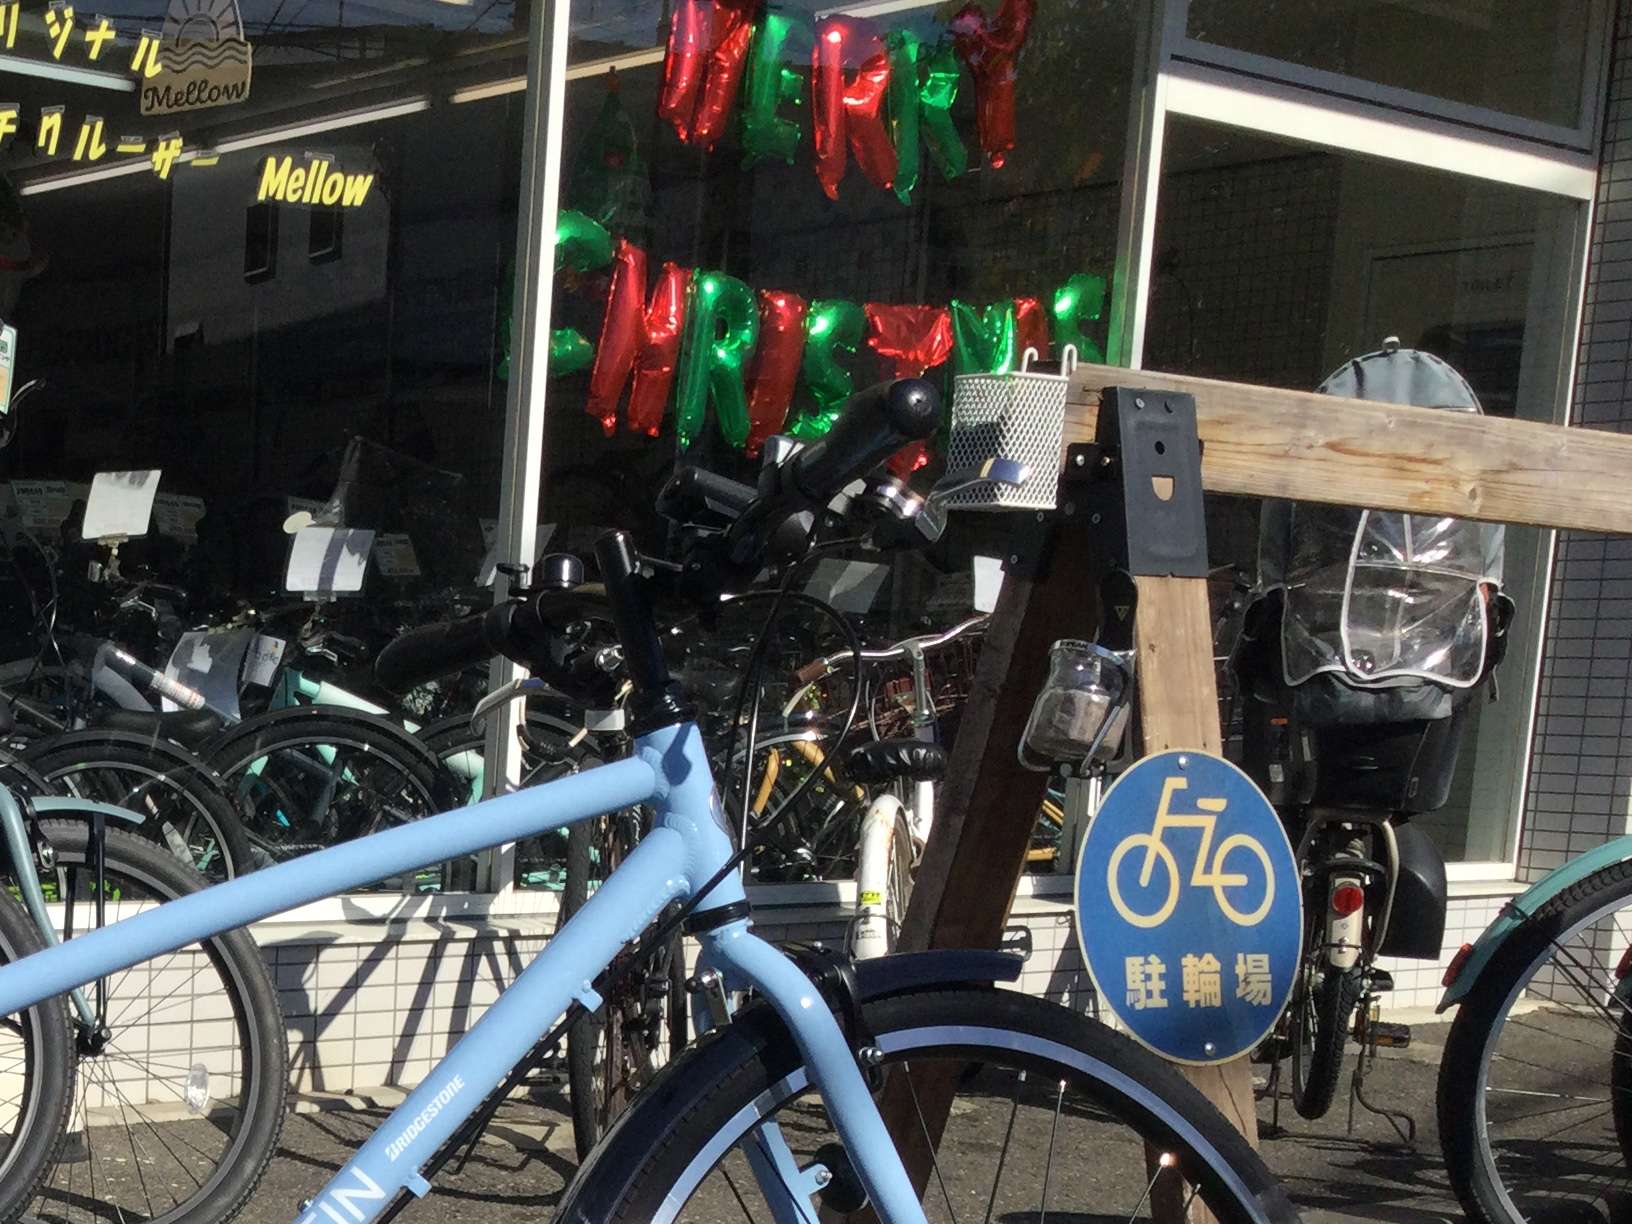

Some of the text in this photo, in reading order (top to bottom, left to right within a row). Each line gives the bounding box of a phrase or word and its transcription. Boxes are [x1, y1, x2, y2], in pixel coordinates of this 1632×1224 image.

[143, 82, 246, 112] Mellow
[257, 155, 373, 207] Mellow
[1125, 953, 1272, 1010] 駐輪場
[385, 1073, 465, 1163] BRIDGESTONE
